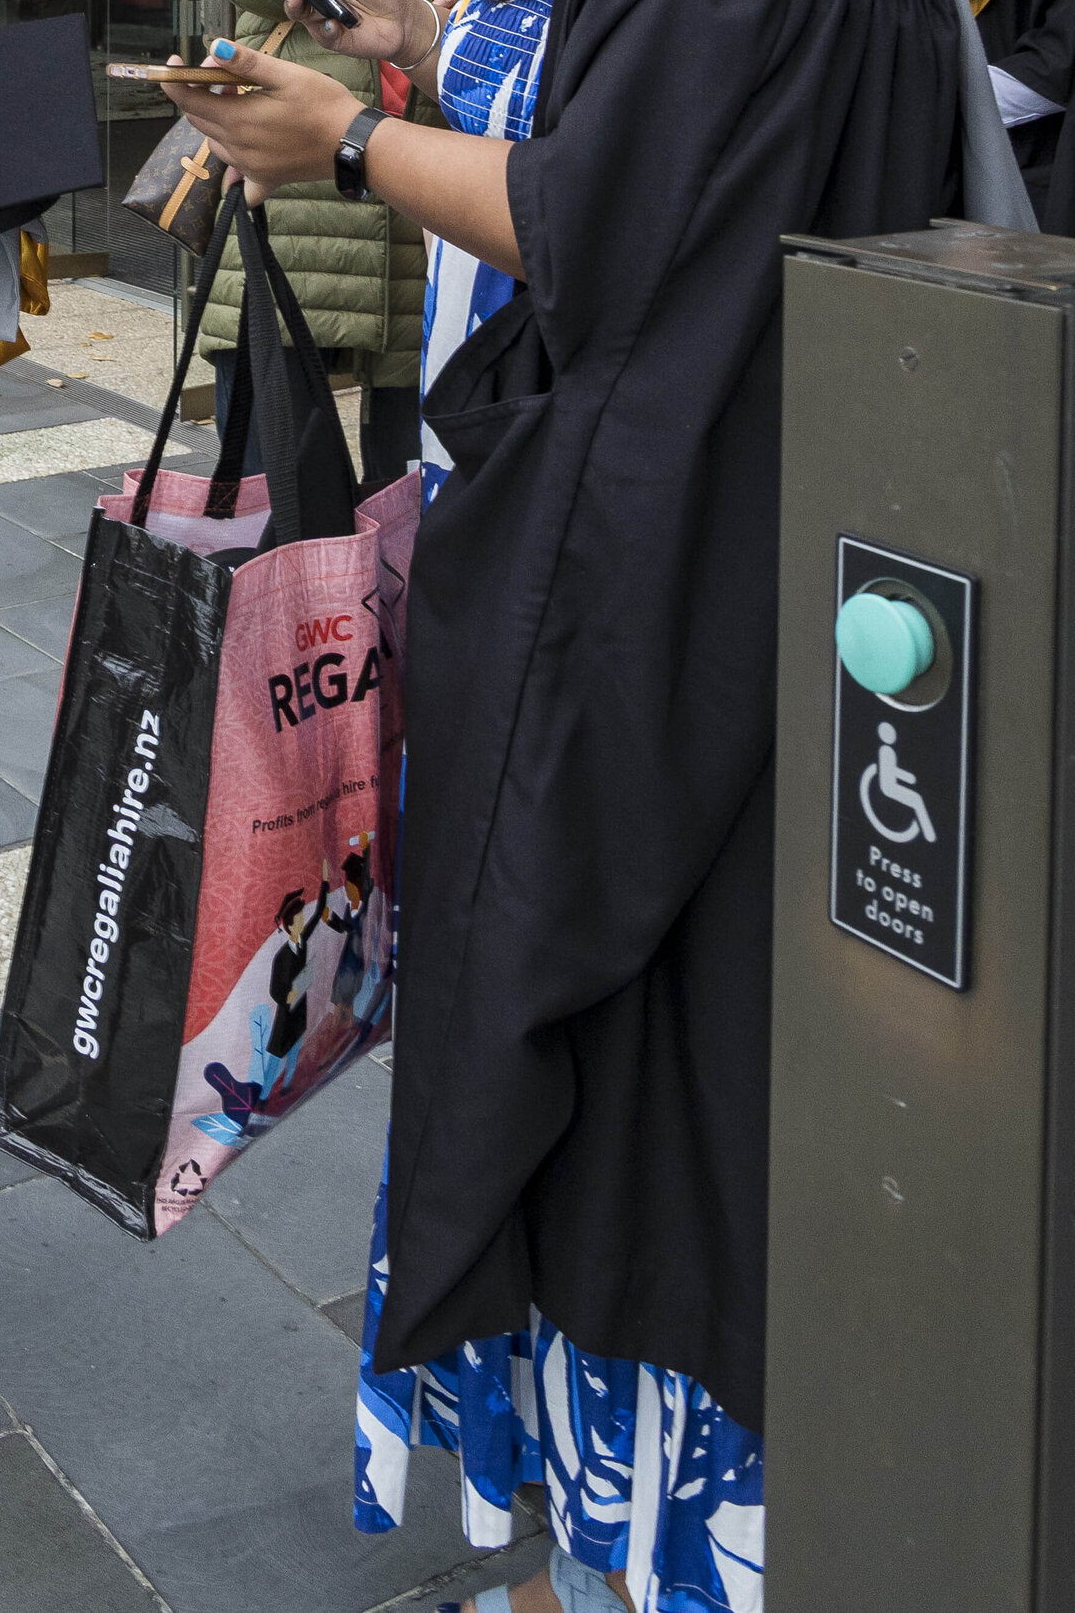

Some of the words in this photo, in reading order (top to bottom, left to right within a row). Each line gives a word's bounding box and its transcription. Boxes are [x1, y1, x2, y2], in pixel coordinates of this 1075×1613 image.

[296, 615, 354, 652] GWC
[268, 638, 388, 732] REGA
[252, 812, 294, 834] Profits
[297, 801, 316, 823] from
[342, 779, 366, 795] hire
[73, 709, 160, 1060] gwcregaliahire.nz
[869, 845, 922, 888] Press
[855, 868, 876, 892] to
[882, 886, 934, 923] open
[865, 899, 924, 945] doors
